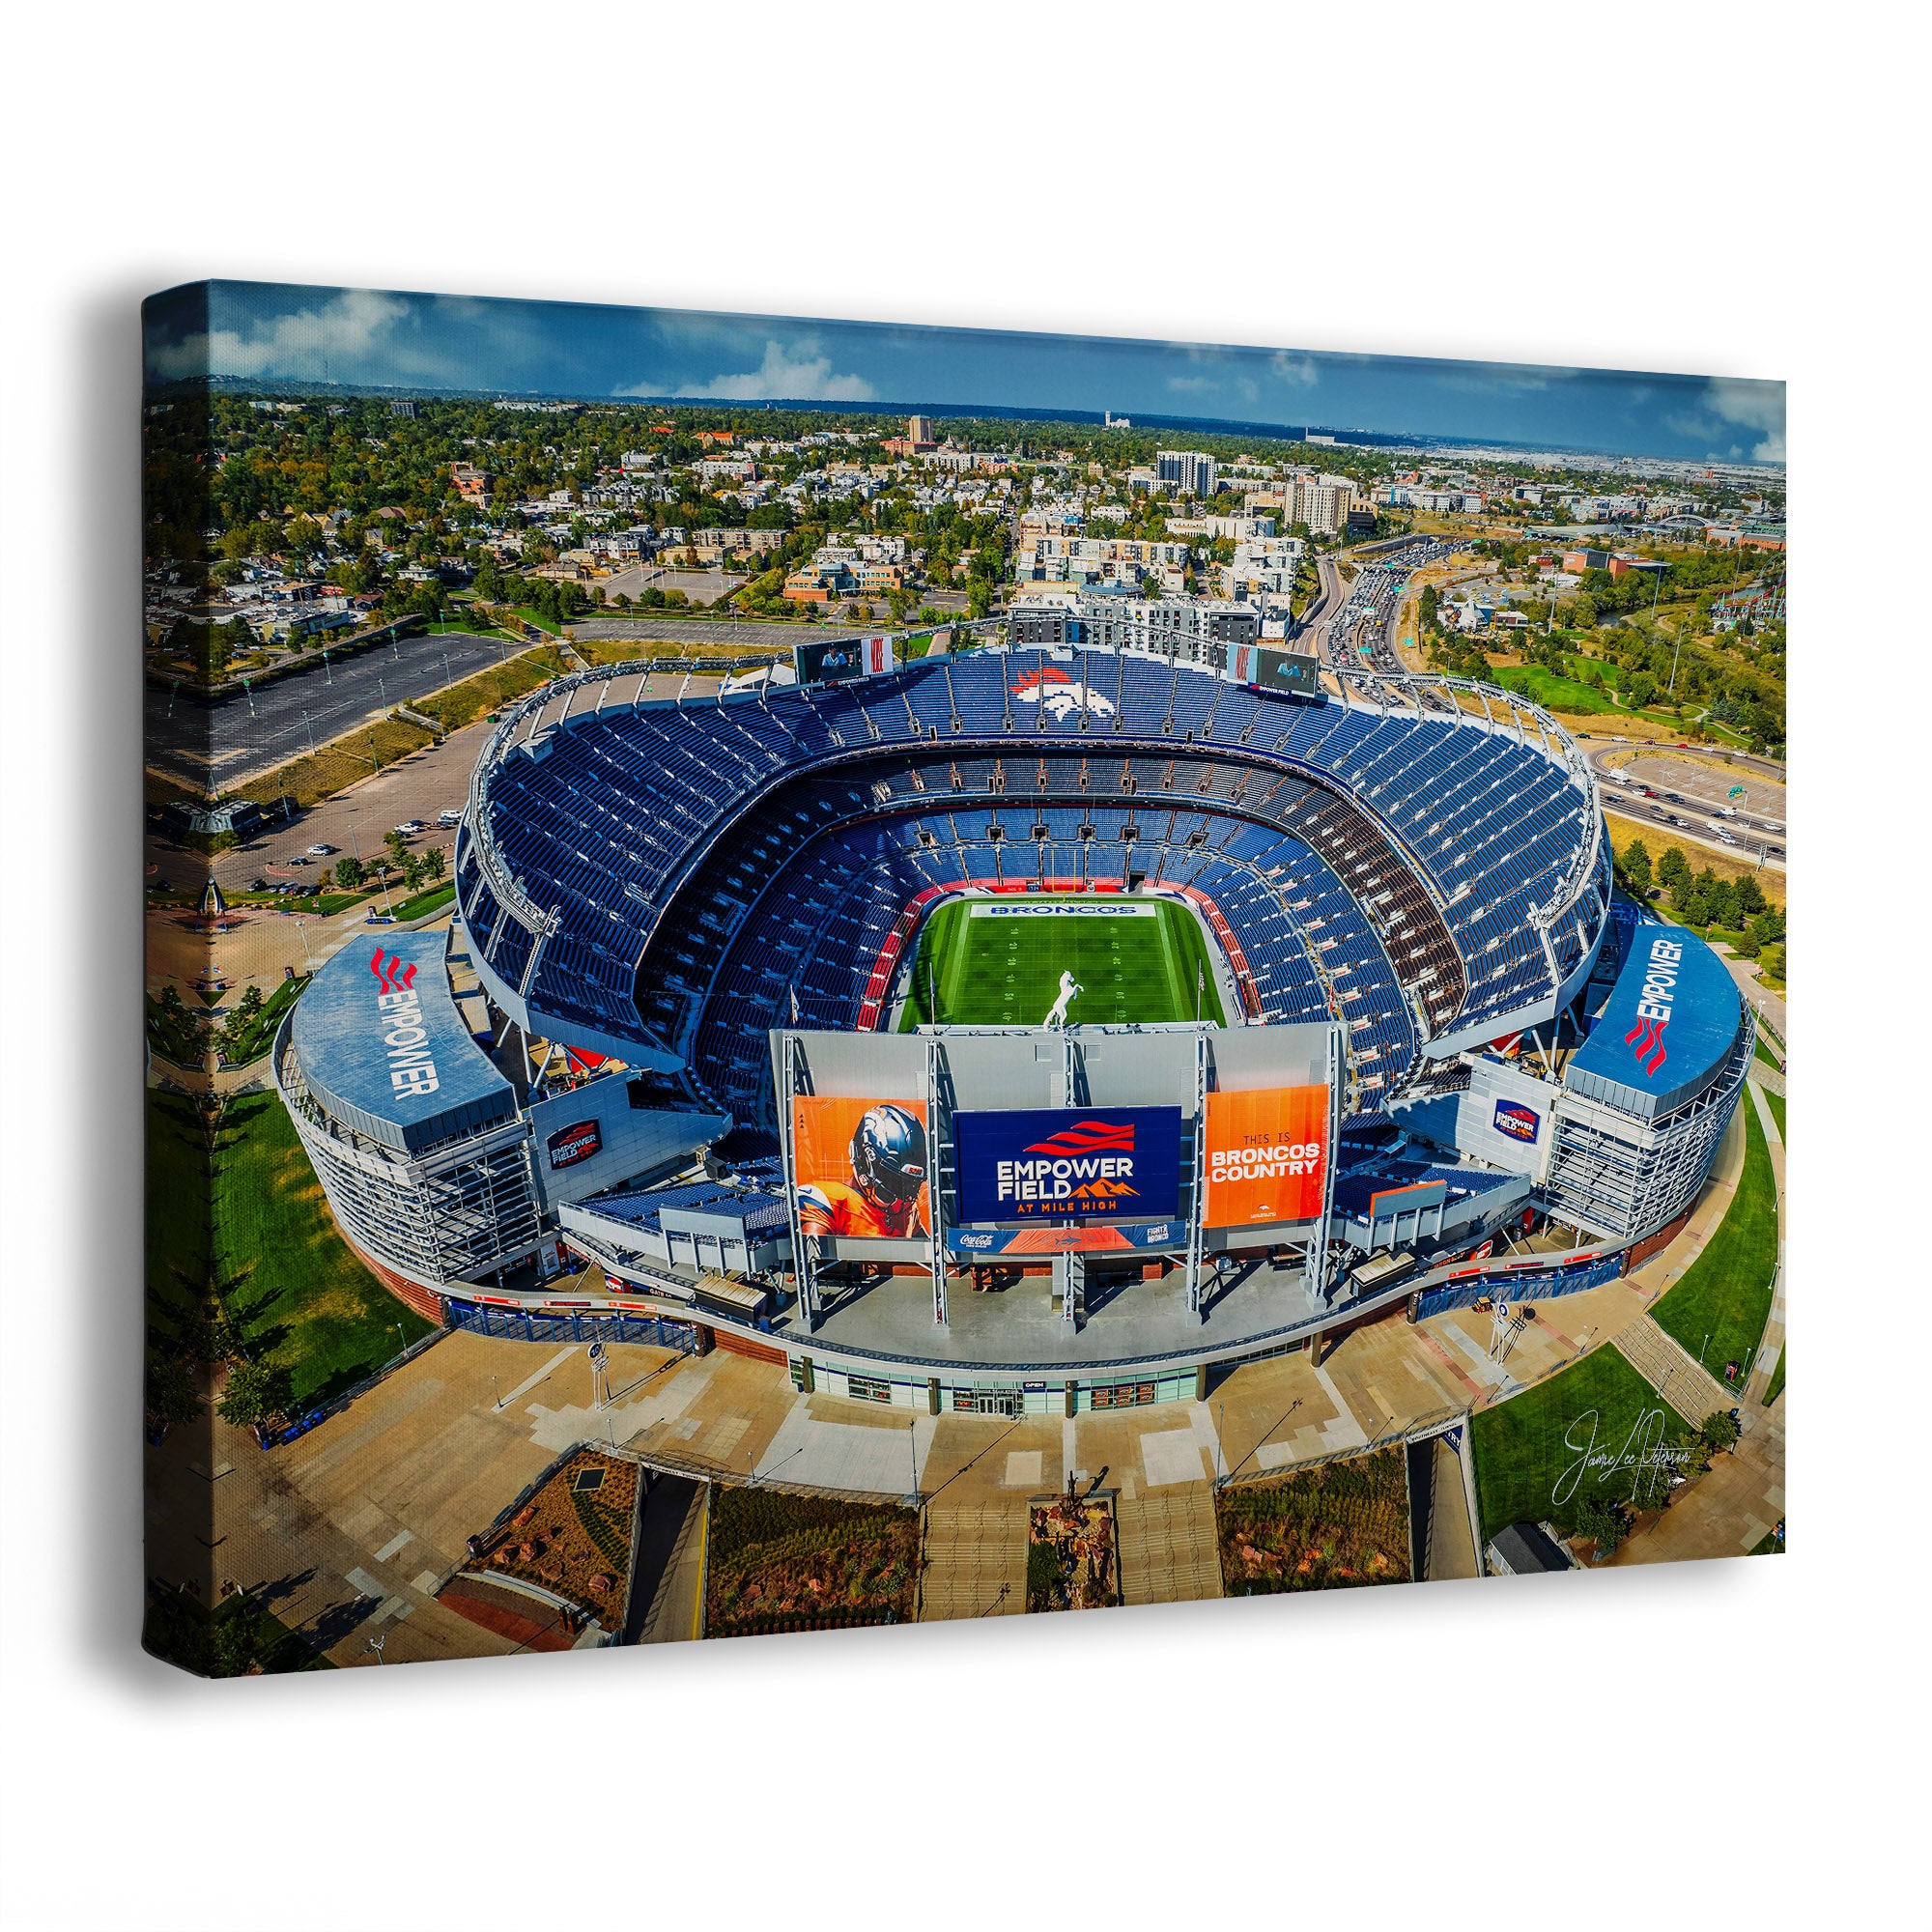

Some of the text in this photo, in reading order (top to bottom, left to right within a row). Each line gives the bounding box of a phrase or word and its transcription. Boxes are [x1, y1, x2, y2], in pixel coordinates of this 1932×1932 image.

[991, 906, 1136, 915] BRONCOS
[1636, 939, 1683, 1022] EMPOWER
[378, 989, 440, 1101] EMPOWER
[1495, 1118, 1517, 1131] FIELD
[1497, 1112, 1534, 1132] EMPOWER
[552, 1134, 596, 1157] EMPOWER
[1243, 1131, 1291, 1145] THIS IS
[553, 1149, 578, 1164] FIELD
[1211, 1143, 1321, 1167] BRONCOS
[997, 1157, 1133, 1180] EMPOWER
[1211, 1159, 1319, 1183] COUNTRY
[997, 1179, 1072, 1201] FIELD
[1017, 1201, 1117, 1213] AT MILE HIGH
